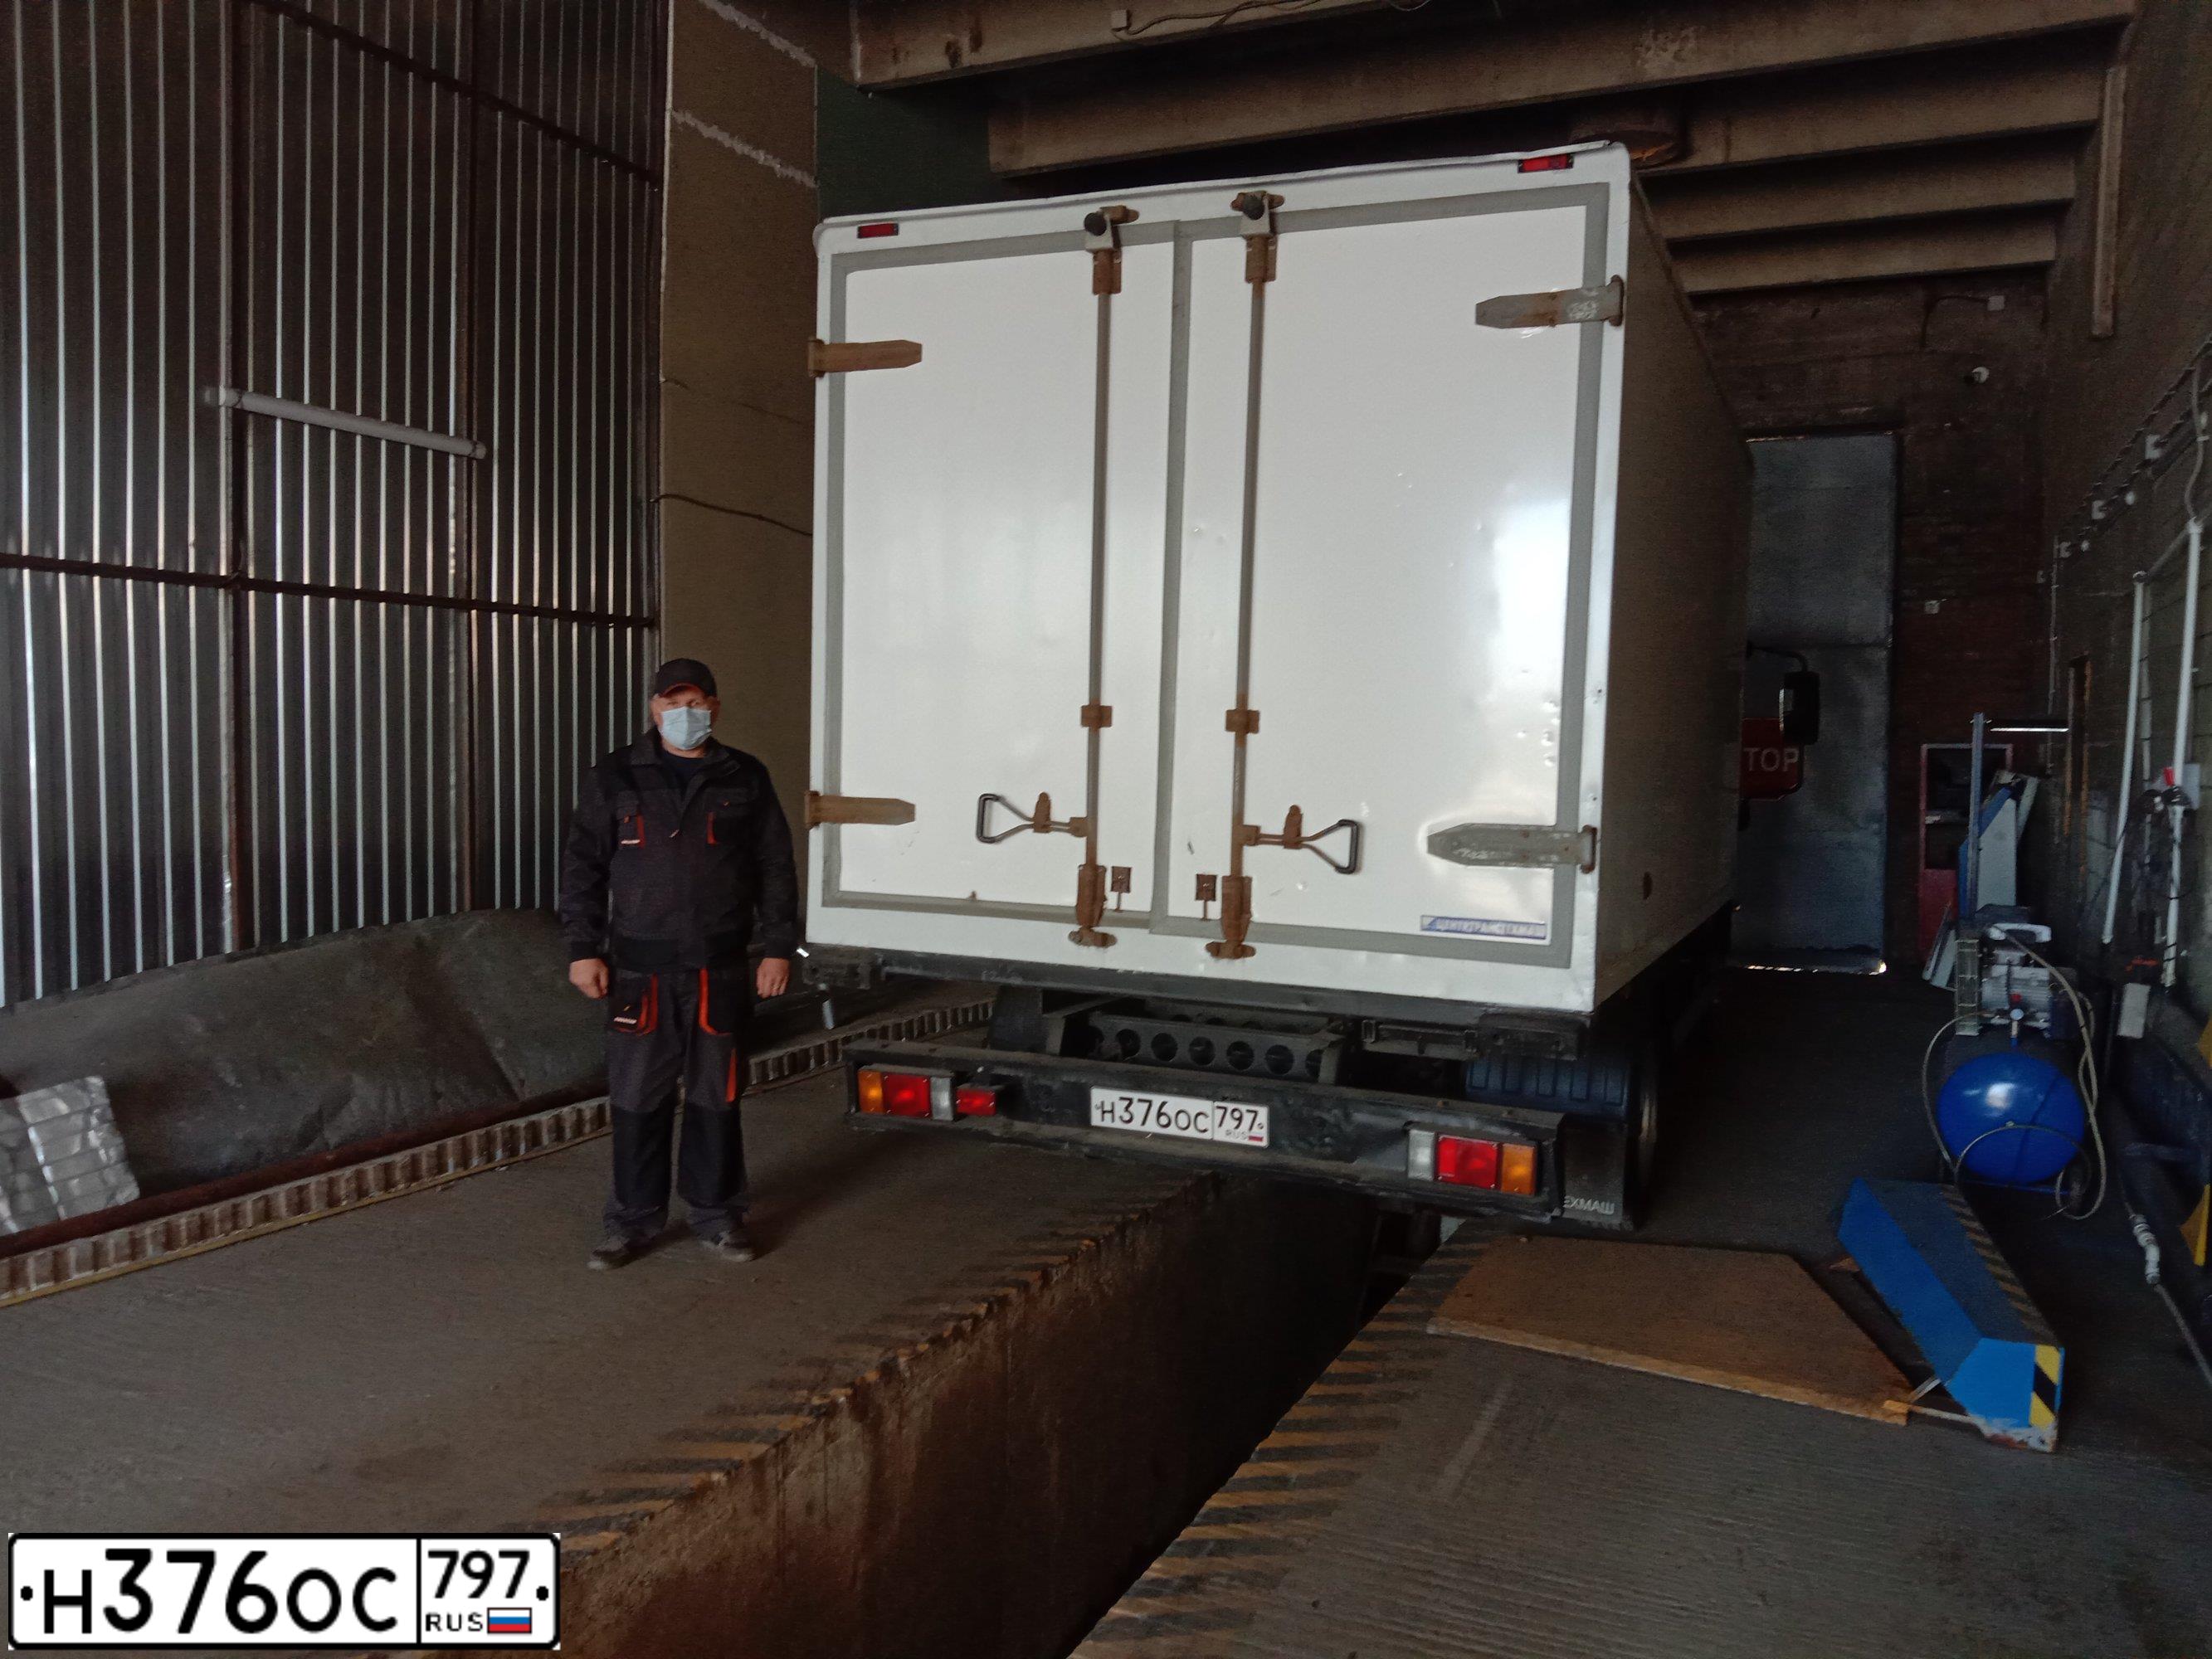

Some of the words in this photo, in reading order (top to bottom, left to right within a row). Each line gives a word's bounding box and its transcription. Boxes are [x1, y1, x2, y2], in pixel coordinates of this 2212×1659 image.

[1743, 747, 1800, 771] TOP
[1100, 1097, 1209, 1133] Н376ОС
[1216, 1106, 1259, 1131] 797
